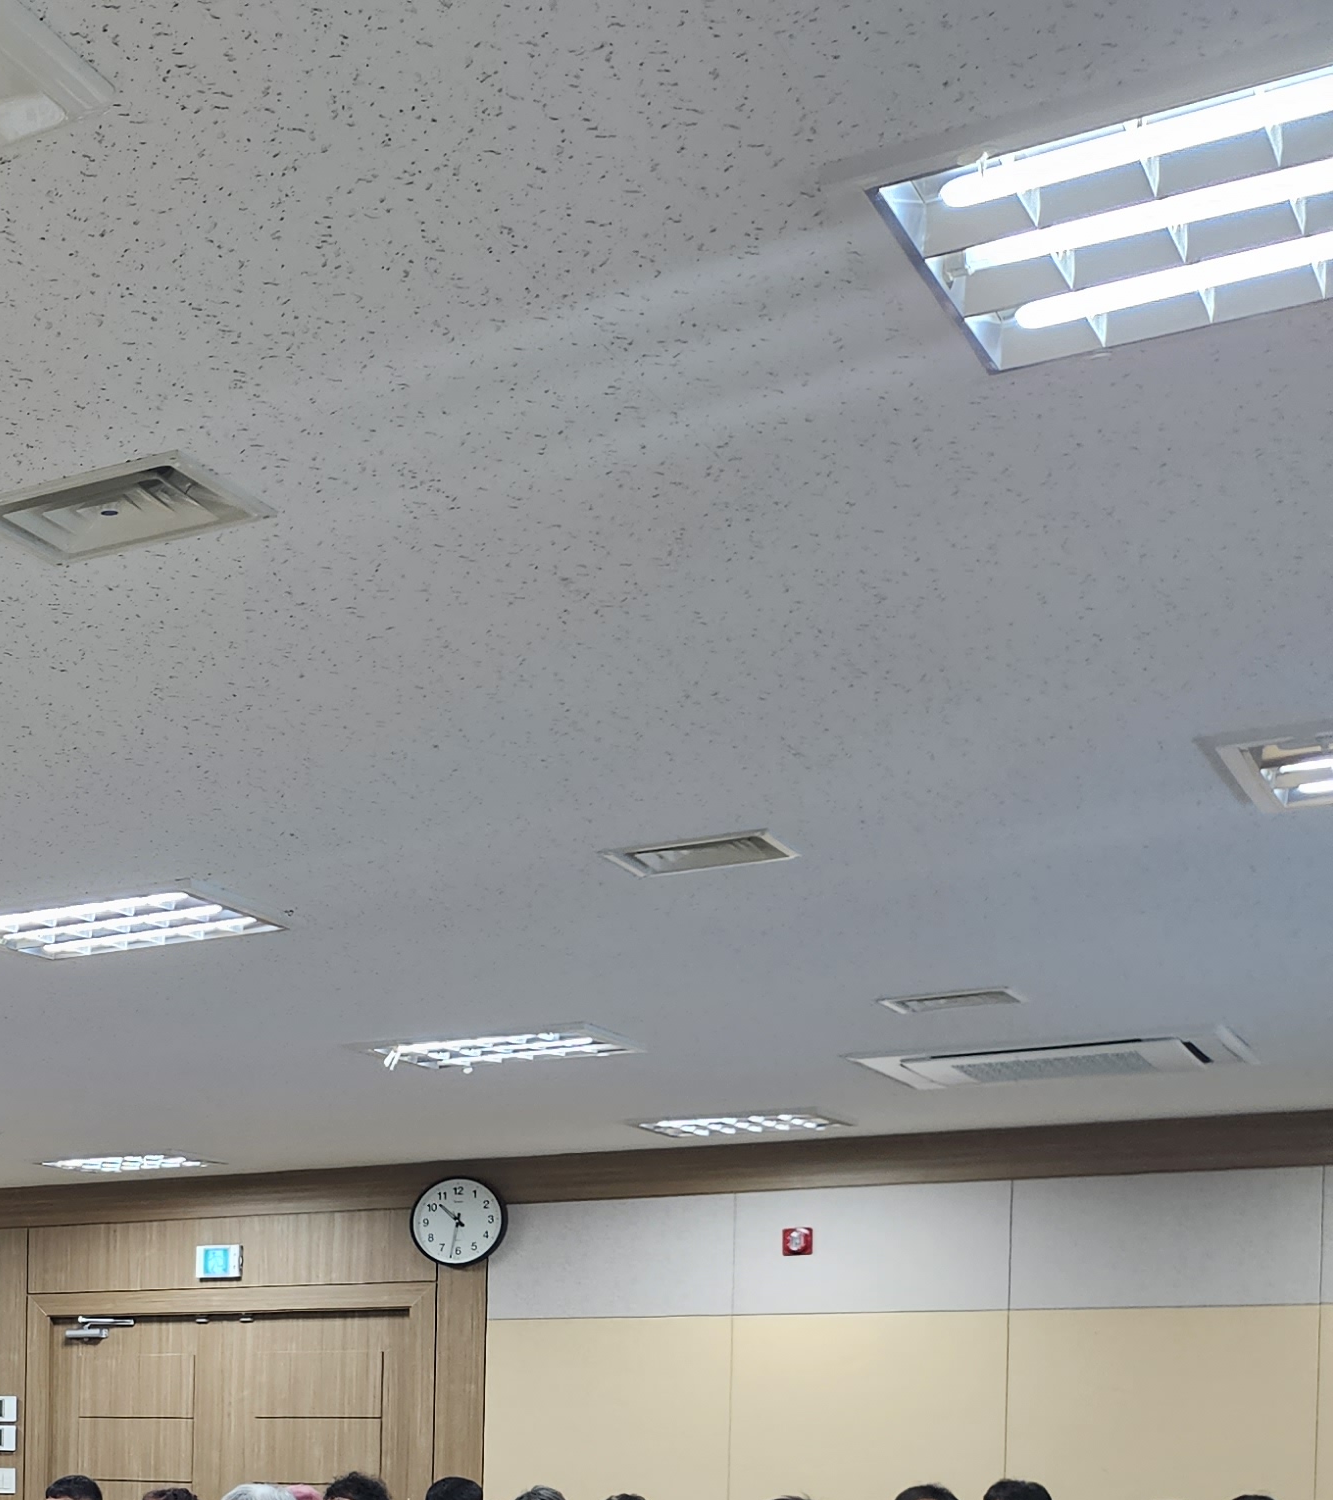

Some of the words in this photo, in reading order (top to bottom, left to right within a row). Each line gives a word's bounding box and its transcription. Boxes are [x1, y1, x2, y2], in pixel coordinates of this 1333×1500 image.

[453, 1186, 464, 1195] 12
[472, 1190, 477, 1198] 1
[437, 1192, 447, 1200] 11
[427, 1203, 438, 1212] 10
[483, 1200, 490, 1209] 2
[422, 1218, 429, 1227] 9
[487, 1215, 494, 1224] 3
[427, 1233, 434, 1242] 8
[483, 1230, 489, 1239] 4
[439, 1243, 445, 1251] 7
[455, 1247, 461, 1255] 6
[471, 1242, 478, 1251] 5
